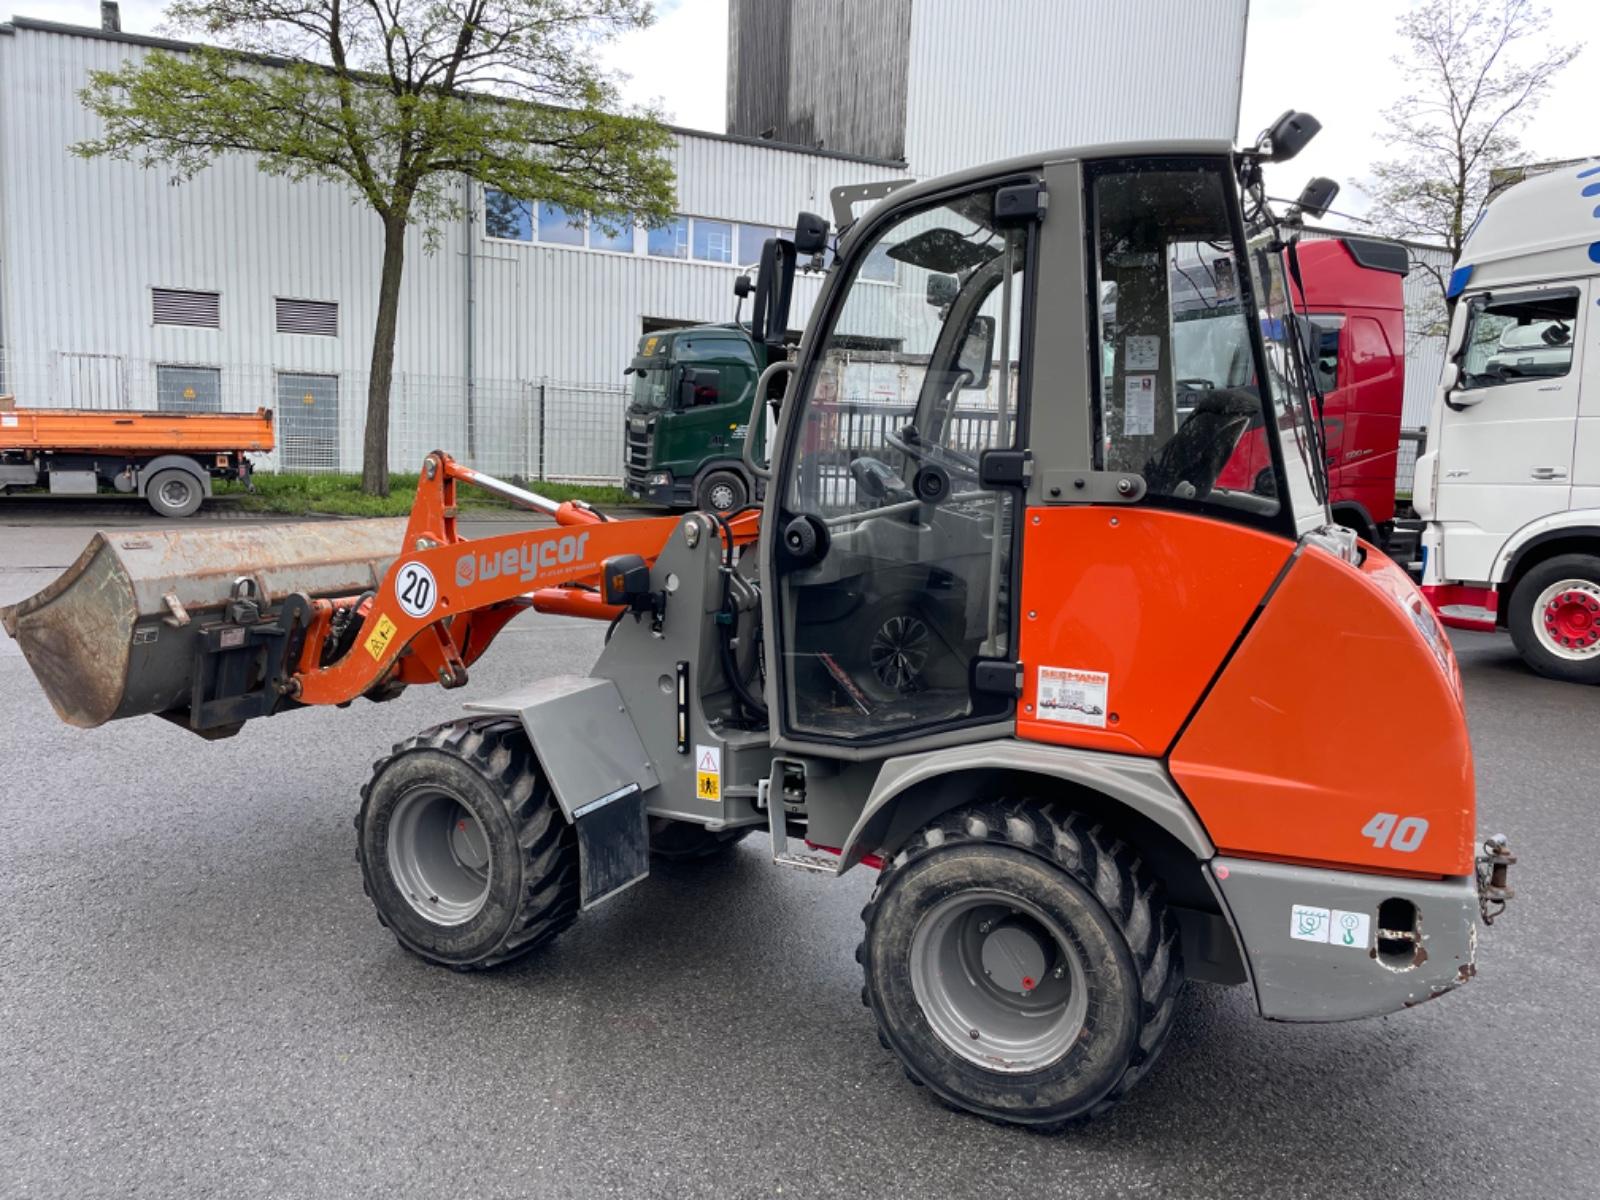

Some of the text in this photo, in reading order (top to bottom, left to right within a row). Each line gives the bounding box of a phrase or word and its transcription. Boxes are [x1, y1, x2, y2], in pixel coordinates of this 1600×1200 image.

[479, 532, 590, 582] weycor
[401, 570, 430, 610] 20
[1361, 812, 1430, 852] 40
